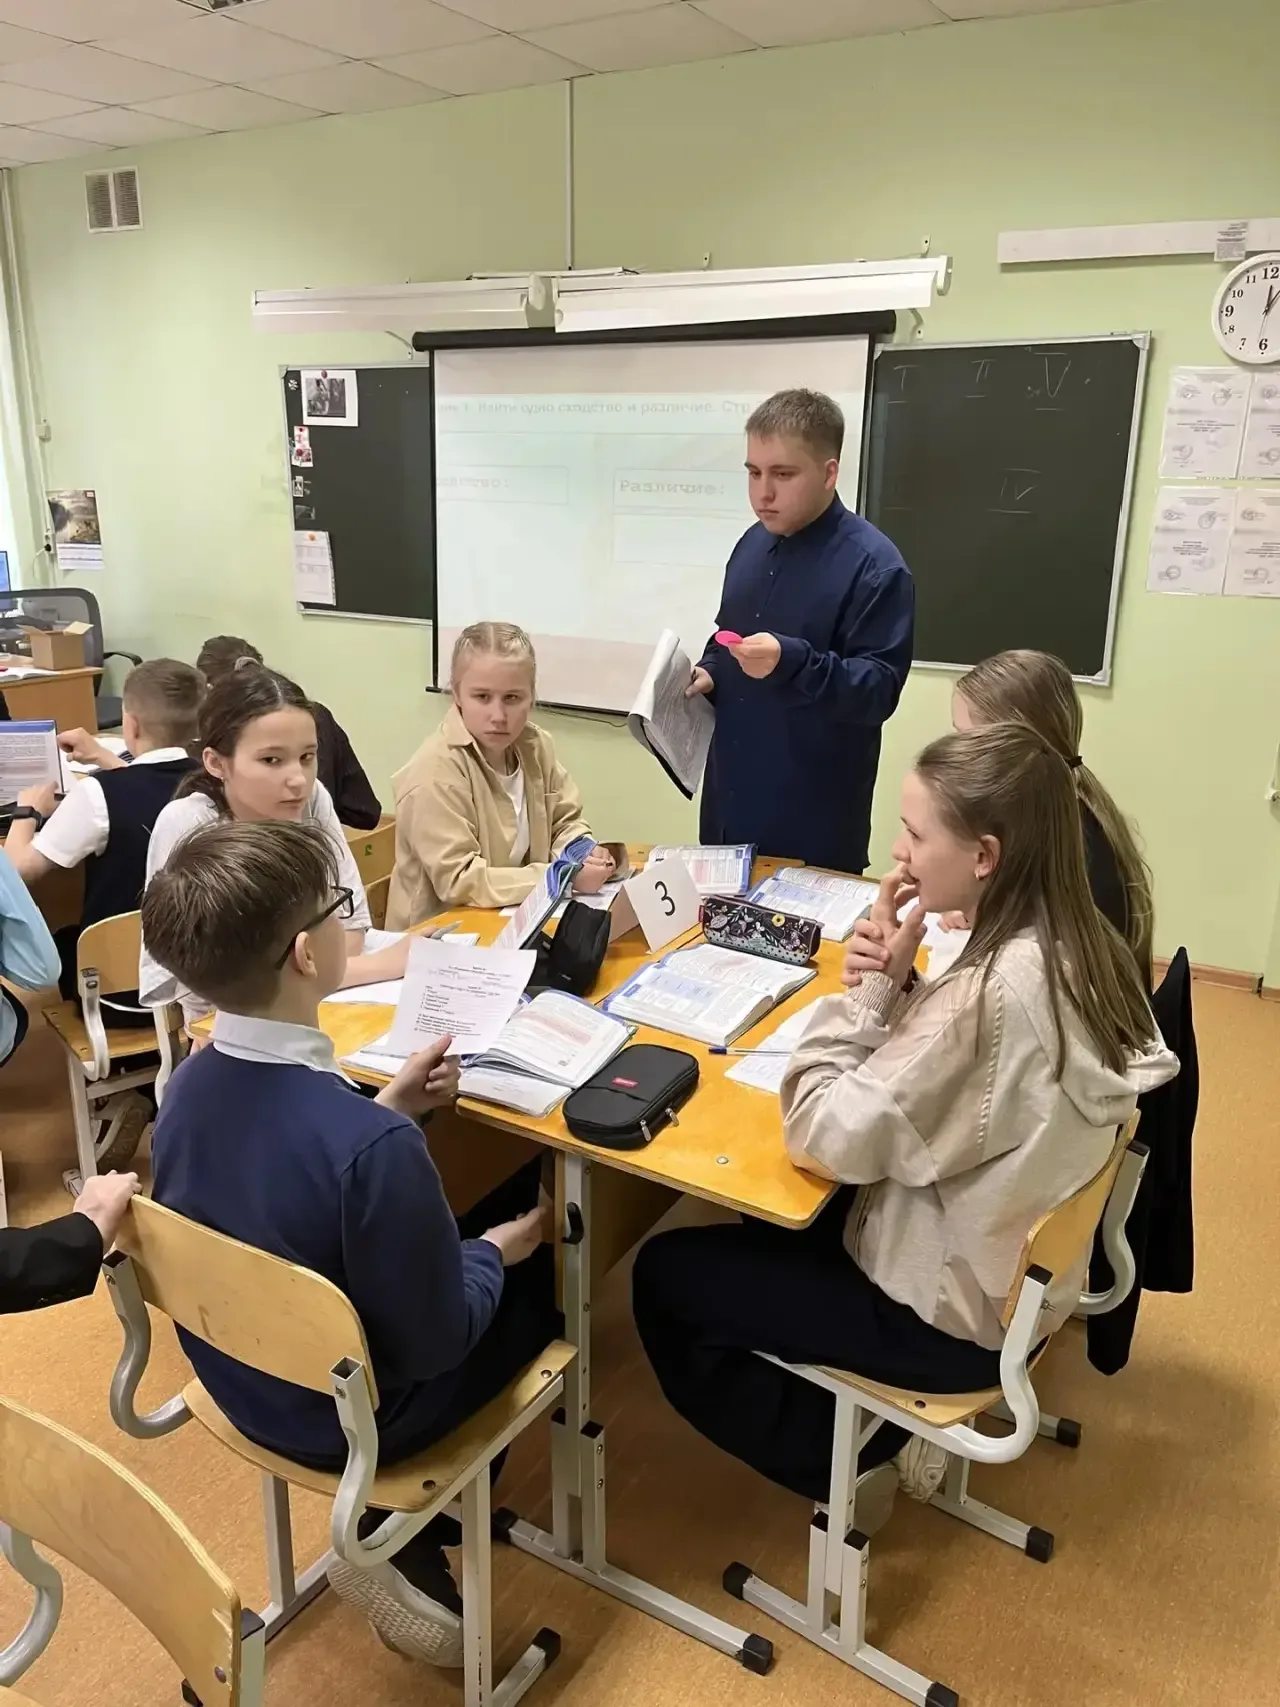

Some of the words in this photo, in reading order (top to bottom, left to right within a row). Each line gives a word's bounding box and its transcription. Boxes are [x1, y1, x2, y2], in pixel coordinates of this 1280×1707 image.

[1246, 274, 1257, 284] 11
[1262, 266, 1280, 280] 12
[1232, 289, 1244, 299] 10
[1224, 305, 1235, 317] 9
[1228, 324, 1236, 334] 8
[1240, 337, 1248, 347] 7
[1258, 338, 1269, 351] 6
[619, 479, 725, 495] Различие:
[654, 880, 676, 917] 3
